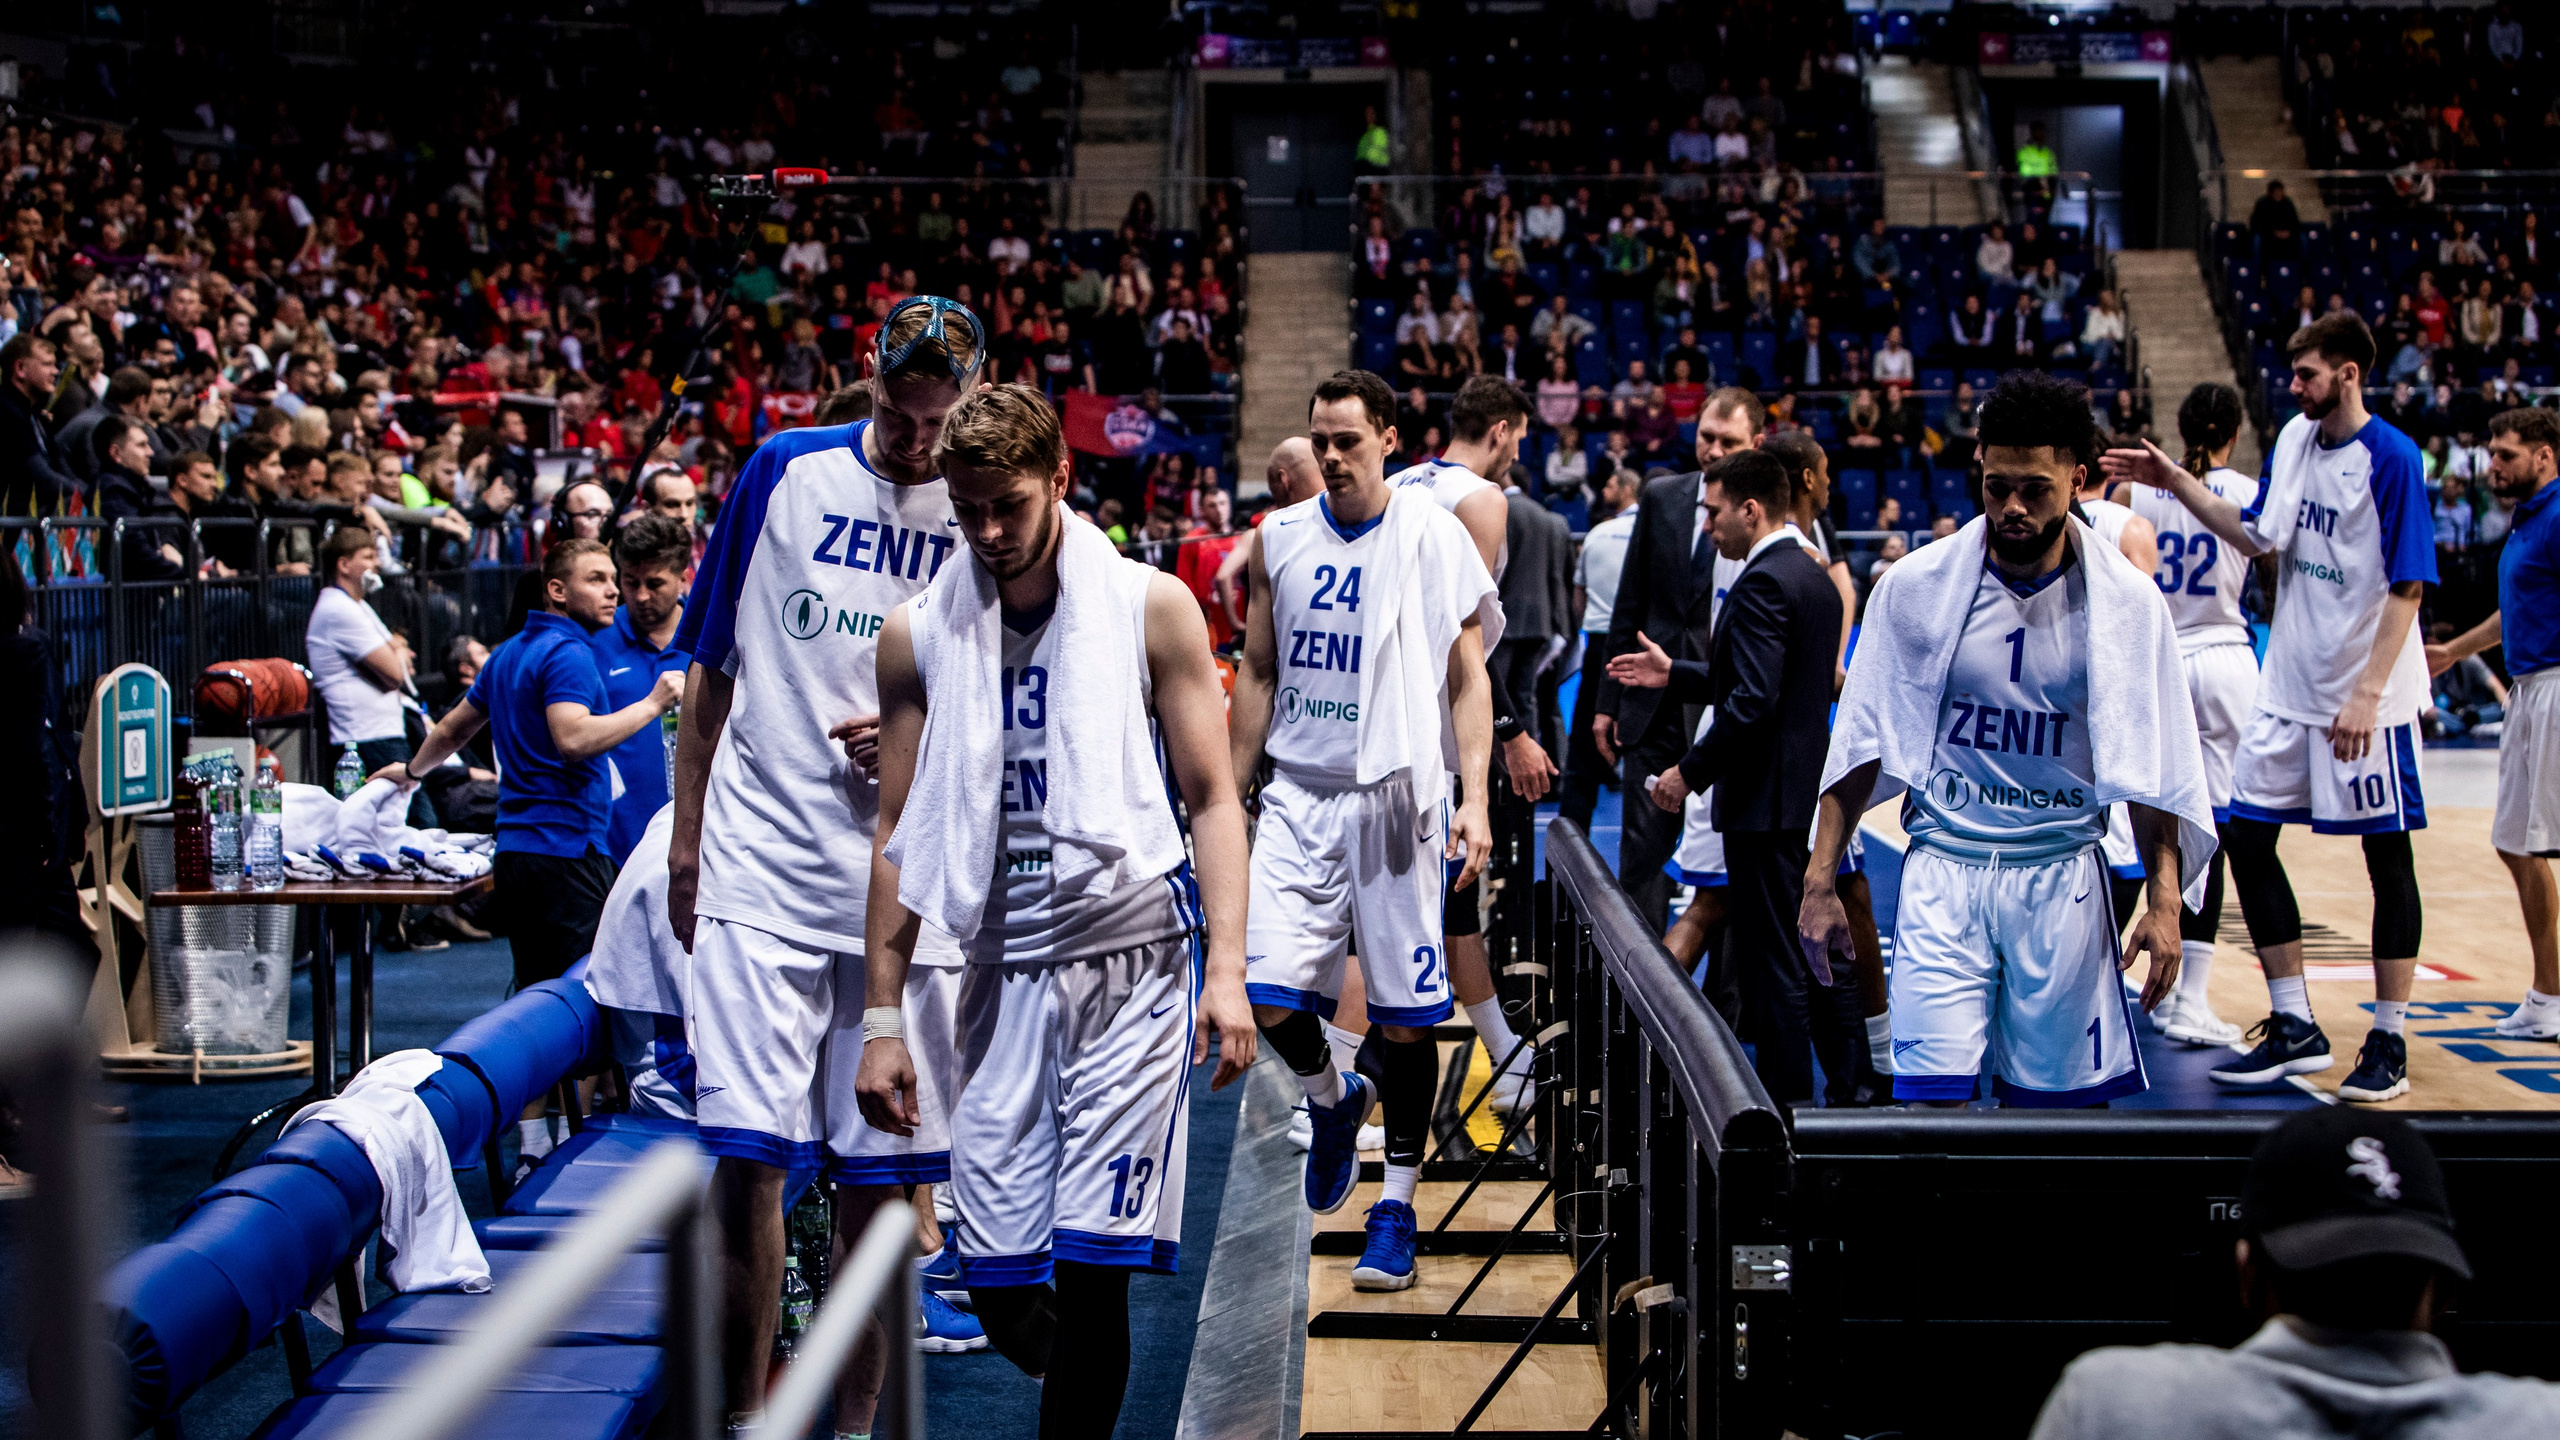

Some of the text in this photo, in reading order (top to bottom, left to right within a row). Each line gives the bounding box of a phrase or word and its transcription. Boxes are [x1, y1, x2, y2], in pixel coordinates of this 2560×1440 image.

[2297, 498, 2338, 537] ENIT
[813, 514, 954, 584] ZENIT
[2154, 531, 2218, 595] 32
[1309, 564, 1362, 612] 24
[1289, 630, 1362, 673] ZENI
[2005, 627, 2025, 683] 1
[1001, 666, 1048, 730] 13
[1305, 698, 1359, 722] NIPIG
[1947, 701, 2069, 757] ZENIT
[1978, 784, 2084, 809] NIPIGAS
[2348, 773, 2386, 811] 10
[2087, 1016, 2102, 1071] 1
[1108, 1153, 1153, 1219] 13
